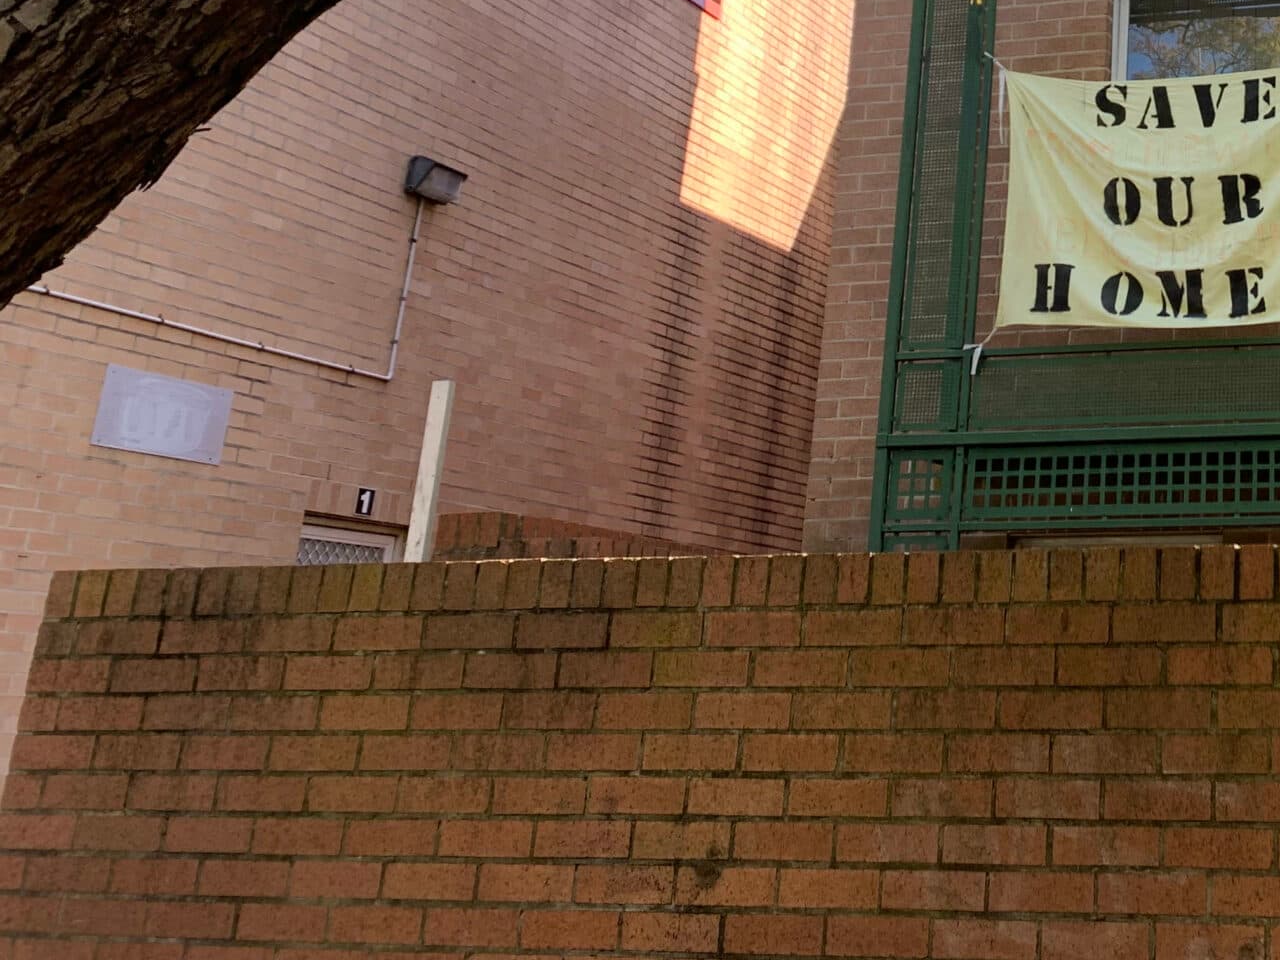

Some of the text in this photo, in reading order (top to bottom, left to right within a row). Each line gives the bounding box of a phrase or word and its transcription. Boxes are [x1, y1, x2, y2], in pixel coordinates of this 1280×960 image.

[1096, 76, 1276, 129] SAVE
[1104, 173, 1264, 227] OUR
[360, 490, 371, 514] 1
